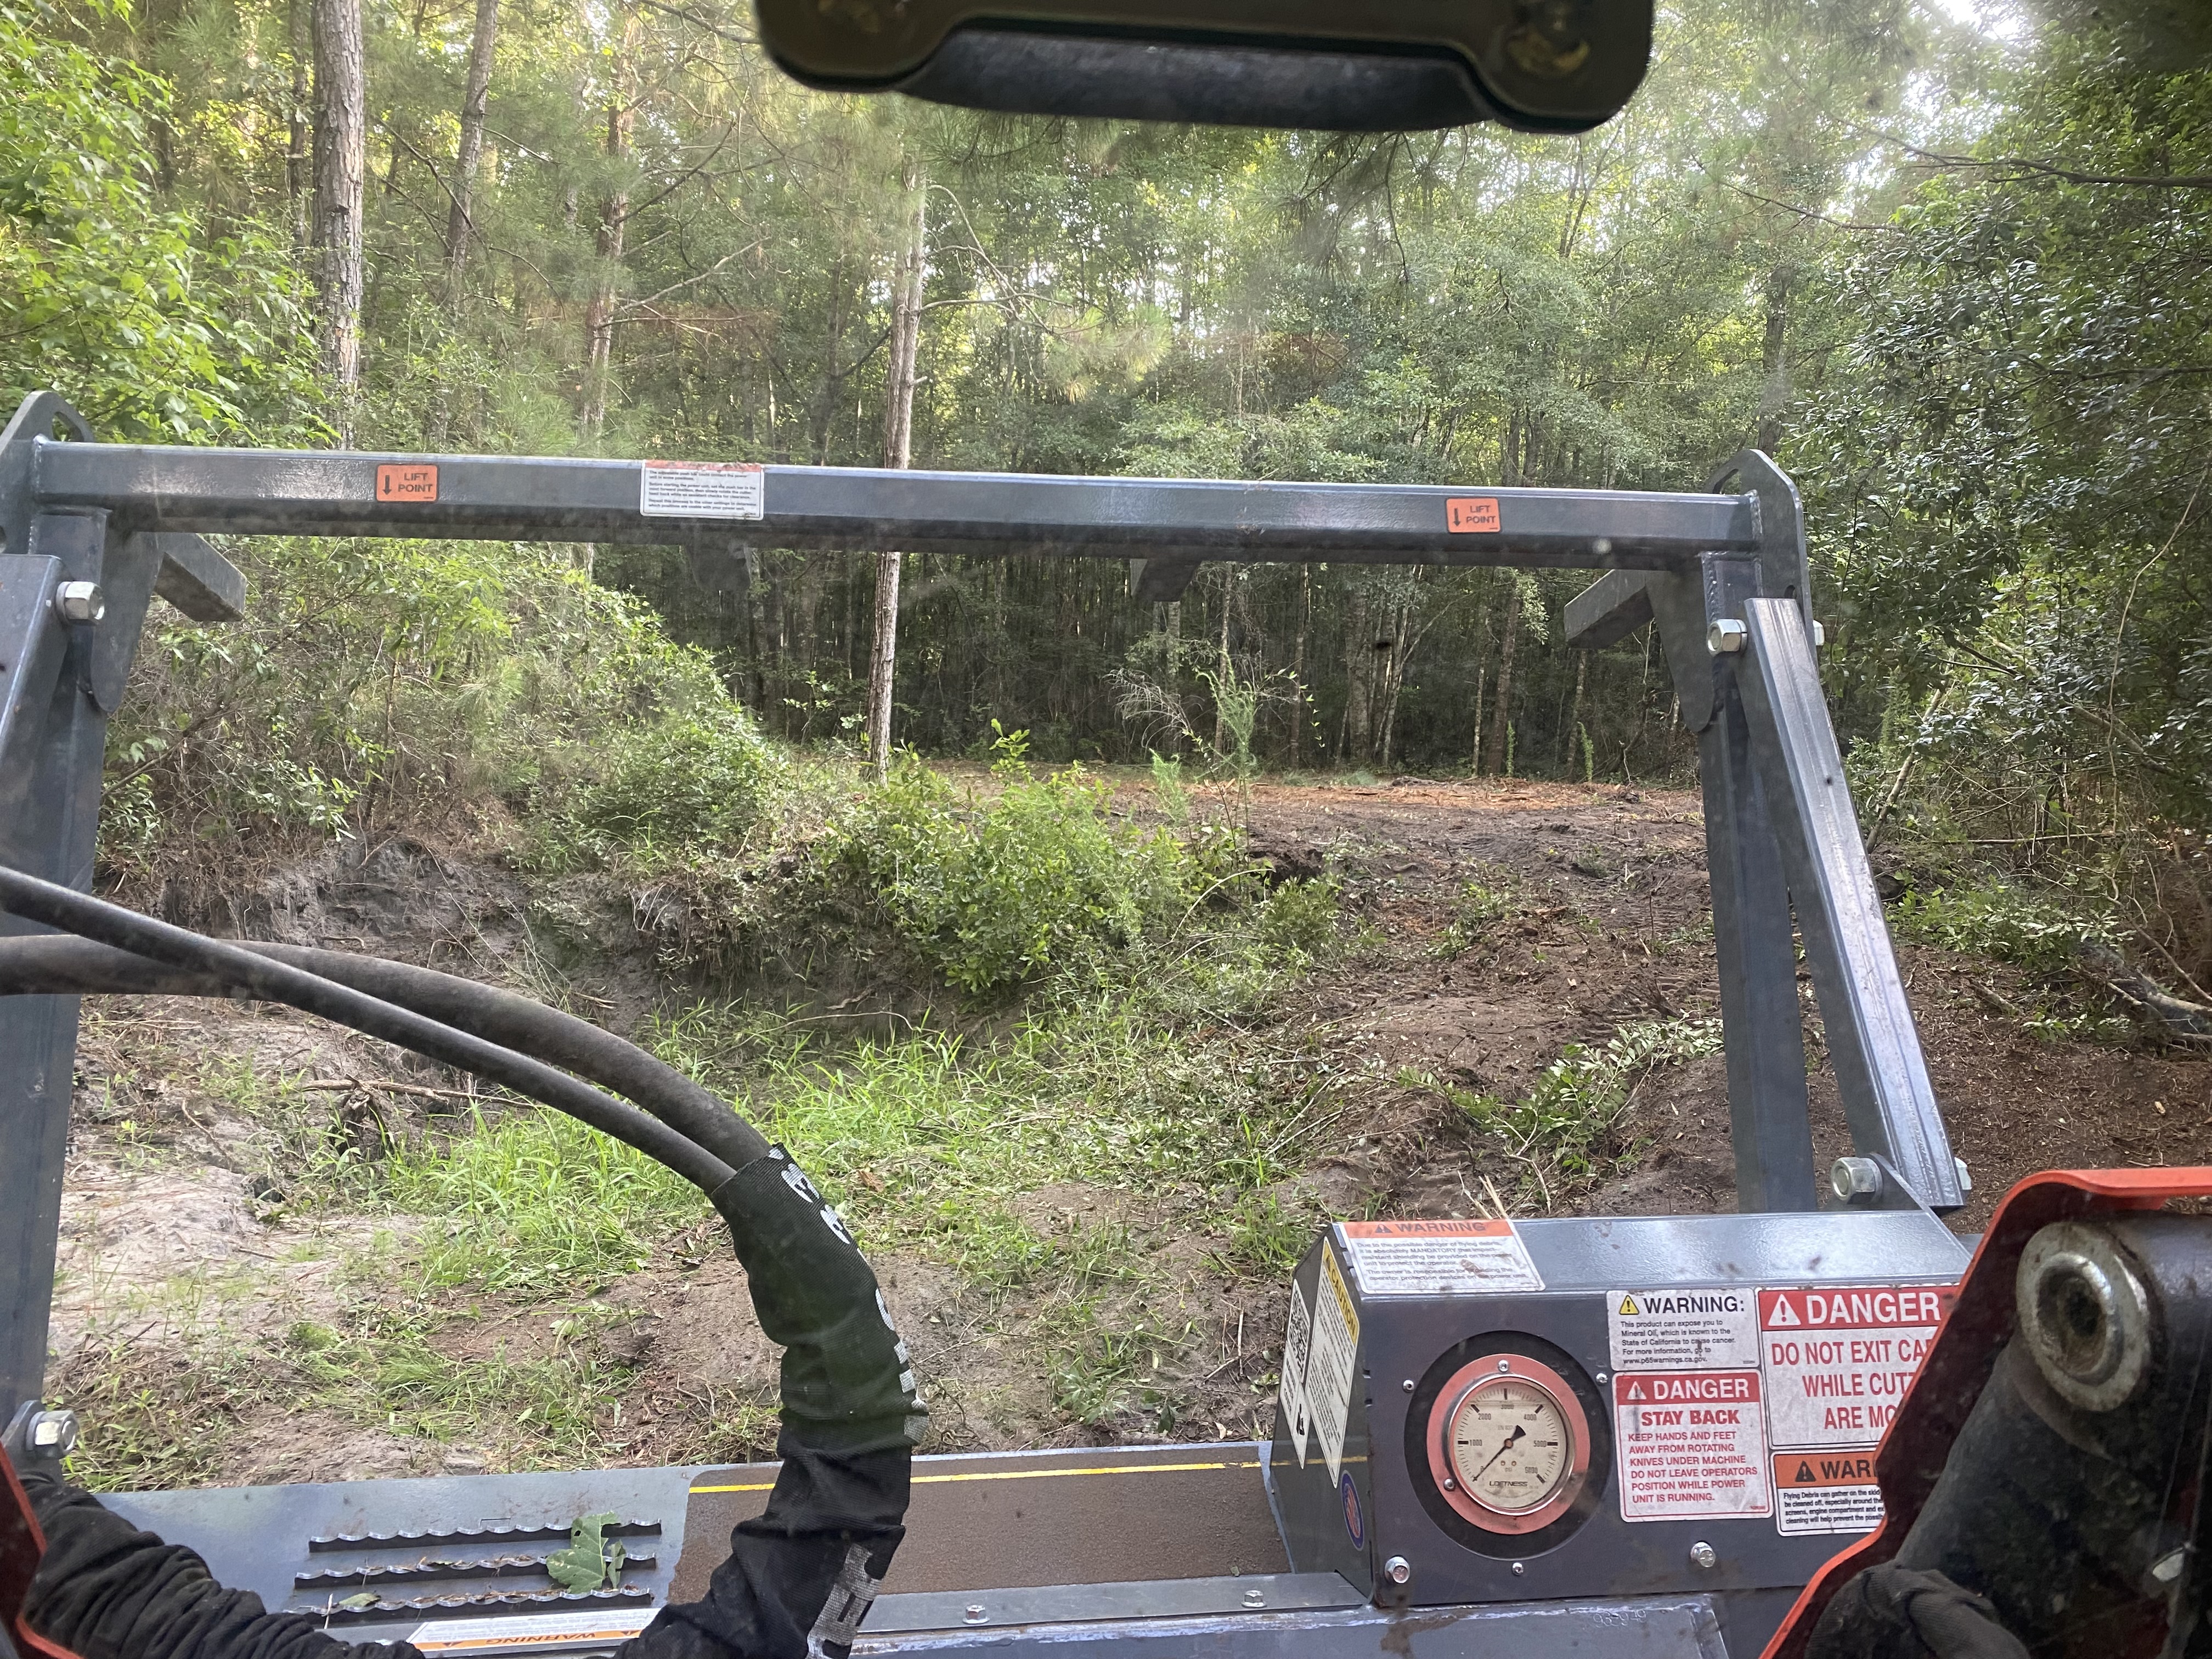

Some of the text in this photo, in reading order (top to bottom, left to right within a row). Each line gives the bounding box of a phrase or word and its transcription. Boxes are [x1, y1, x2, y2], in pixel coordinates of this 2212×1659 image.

[398, 484, 433, 492] POINT
[1394, 1222, 1486, 1232] WARNING
[1643, 1296, 1745, 1314] WARNING:
[1806, 1292, 1941, 1325] DANGER
[1771, 1339, 1933, 1365] DO NOT EXIT CA
[1653, 1379, 1750, 1400] DANGER
[1802, 1374, 1864, 1397] WHILE
[1641, 1409, 1741, 1426] STAY BACK
[1825, 1406, 1863, 1429] ARE
[1628, 1431, 1736, 1441] KEEP HANDS AND FEET
[1629, 1443, 1735, 1454] AWAY FROM ROTATING
[1630, 1455, 1746, 1466] KNIVES UNDER MACHINE
[1631, 1467, 1758, 1479] DO NOT LEAVE OPERATORS
[1632, 1479, 1746, 1491] POSITION WHILE POWER
[1633, 1492, 1715, 1503] UNIT IS RUNNING.
